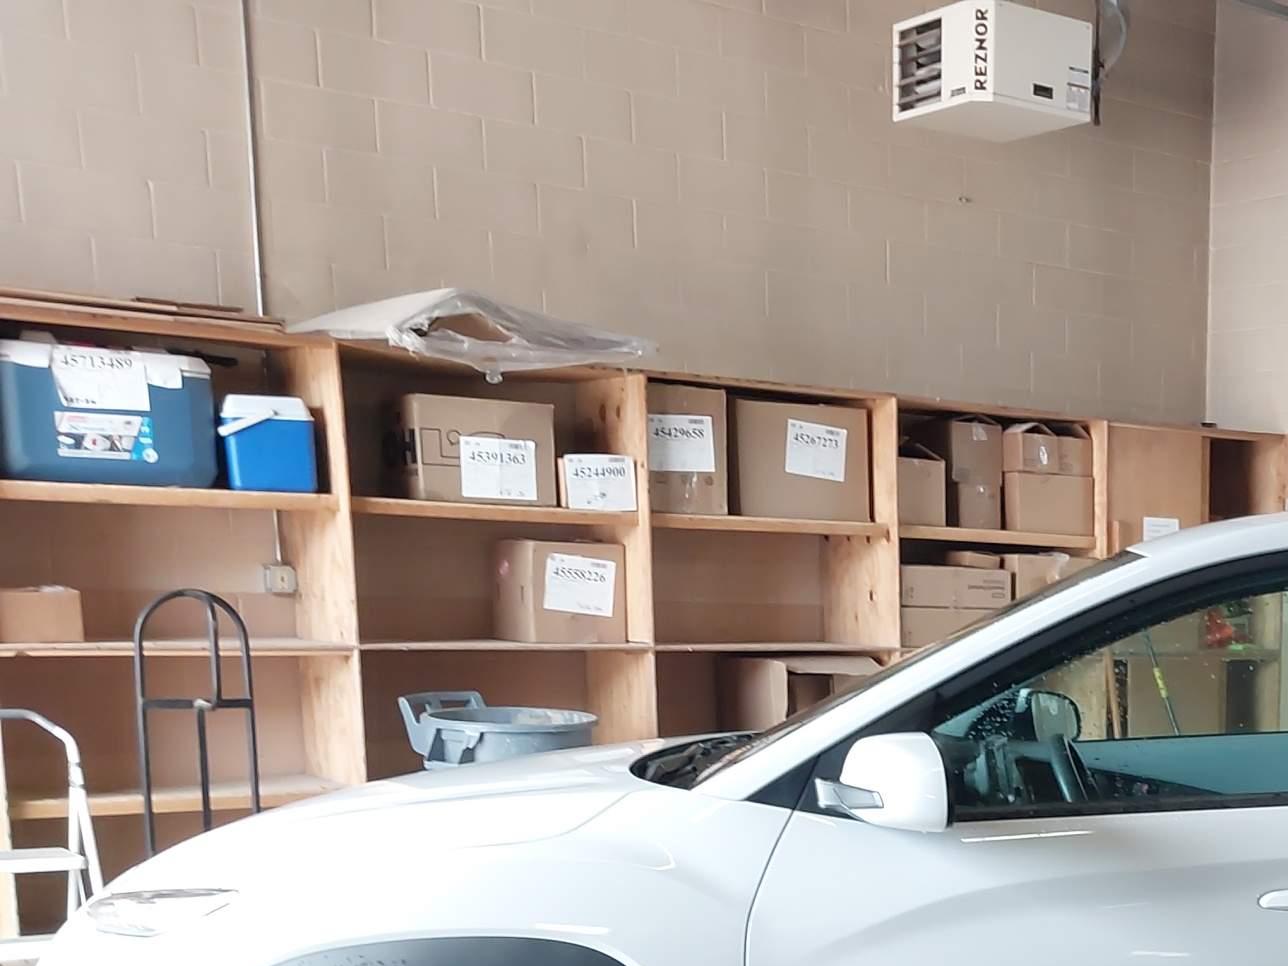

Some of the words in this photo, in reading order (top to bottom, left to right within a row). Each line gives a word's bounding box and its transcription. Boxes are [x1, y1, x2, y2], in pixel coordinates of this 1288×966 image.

[974, 8, 989, 91] REZNOR
[792, 431, 840, 449] 45267273
[468, 450, 526, 465] 45391363
[572, 465, 626, 479] 45244900
